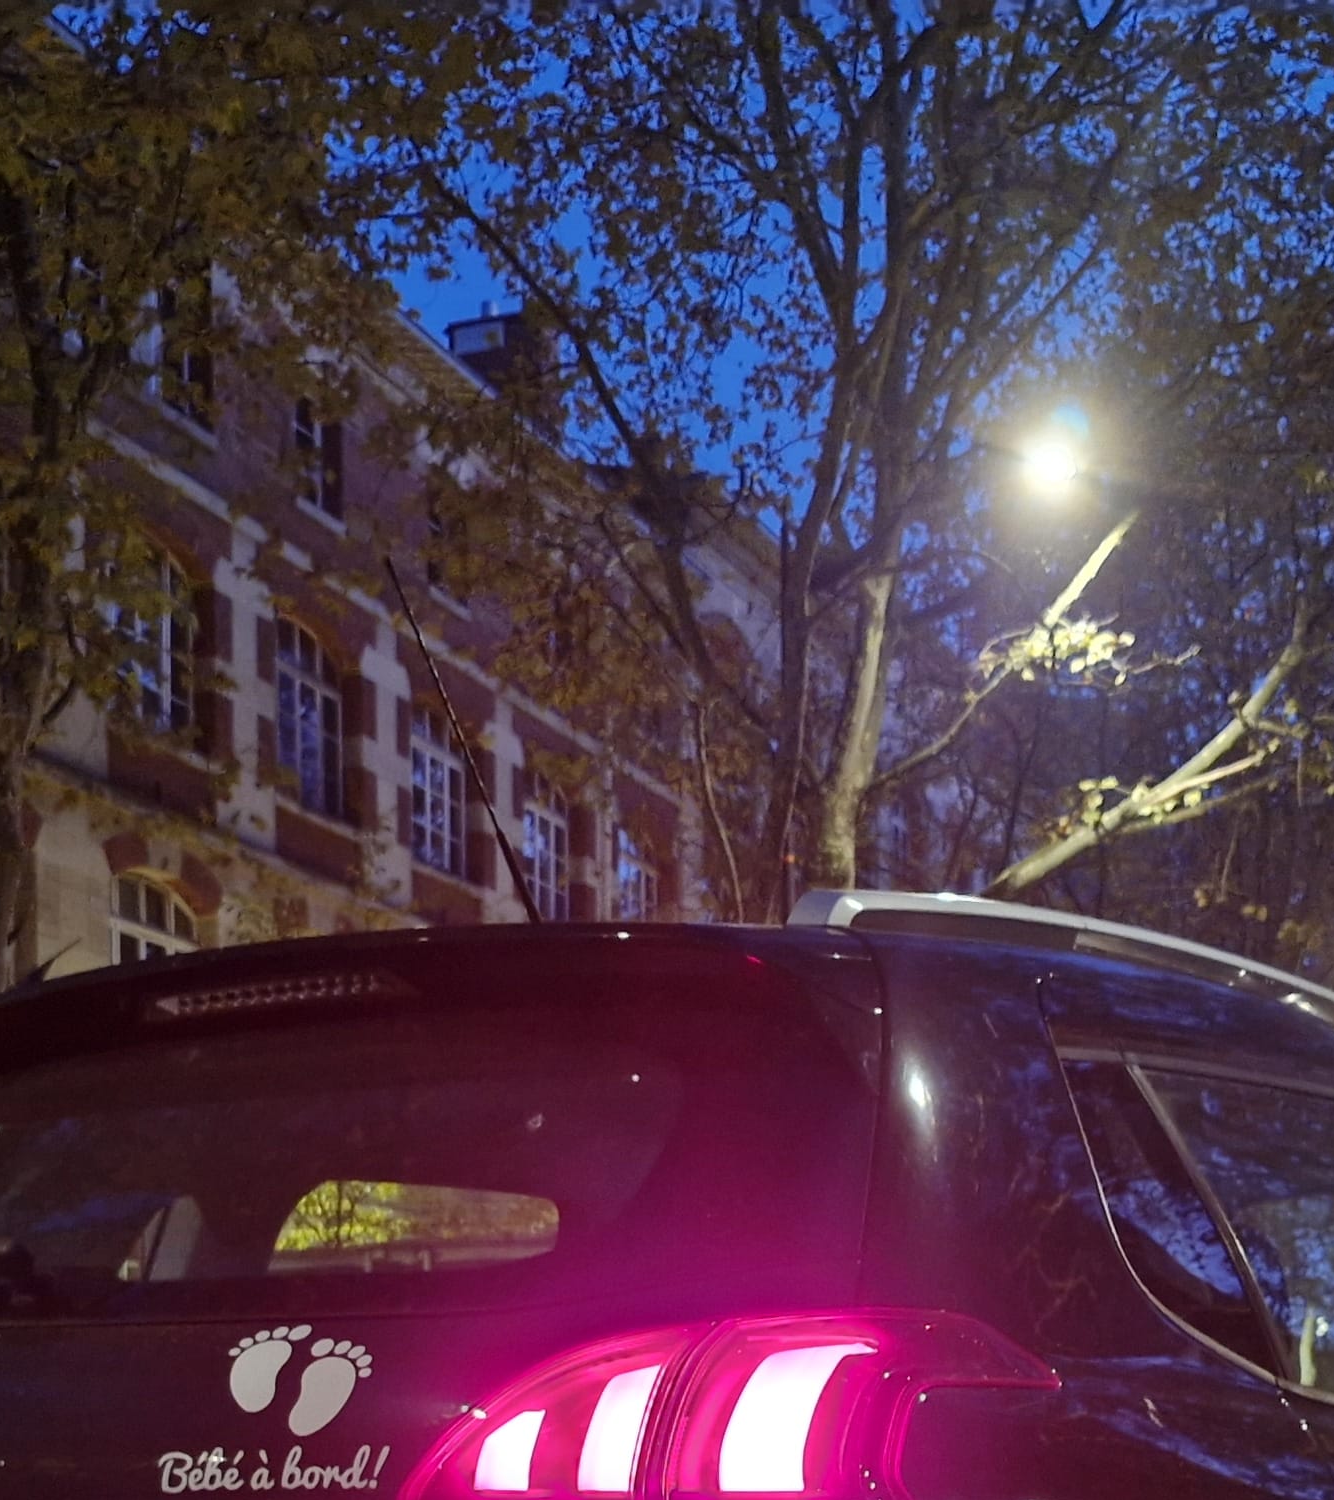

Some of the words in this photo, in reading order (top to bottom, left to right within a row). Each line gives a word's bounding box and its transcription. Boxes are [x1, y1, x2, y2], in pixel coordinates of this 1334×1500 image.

[157, 1447, 244, 1493] Bébé
[250, 1449, 275, 1491] à
[281, 1445, 390, 1490] bord!
